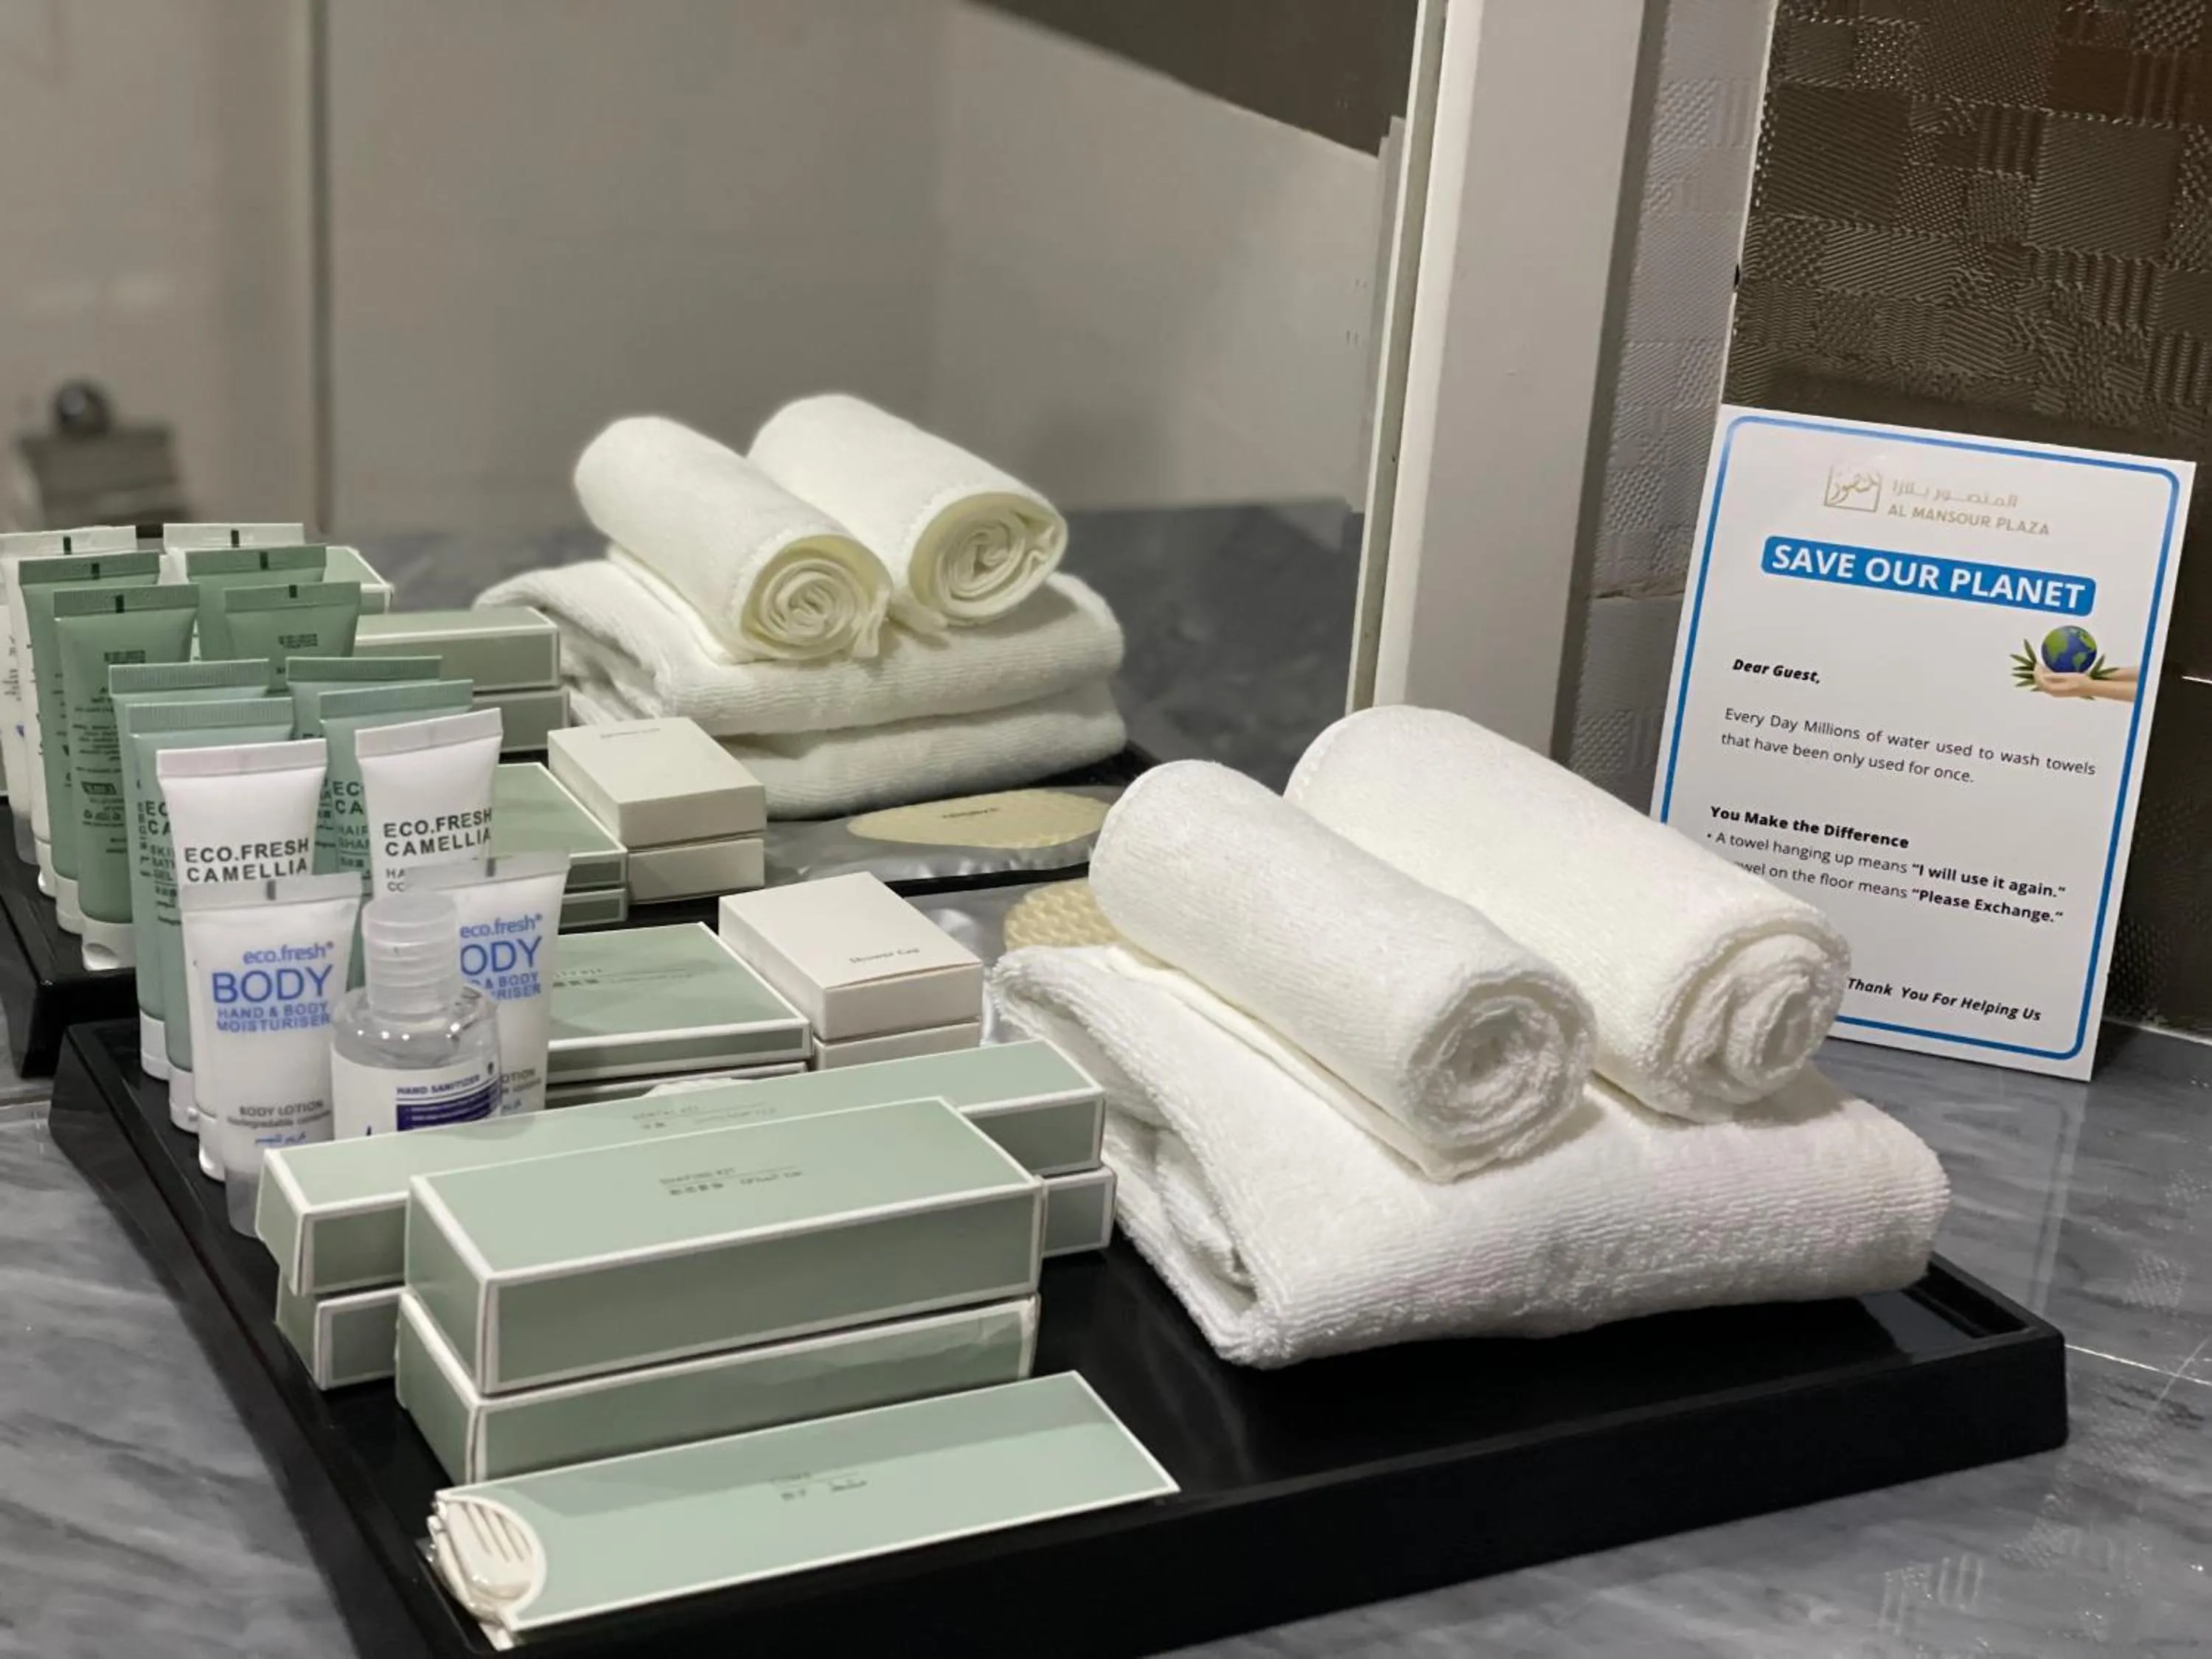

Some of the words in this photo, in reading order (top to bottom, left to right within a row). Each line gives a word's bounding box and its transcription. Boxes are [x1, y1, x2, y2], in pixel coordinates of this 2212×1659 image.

[1888, 504, 1907, 518] AL
[1911, 507, 1991, 528] MANSOUR
[1995, 518, 2051, 536] PLAZA
[1771, 544, 1856, 579] SAVE
[1864, 557, 1940, 591] OUR
[1949, 568, 2086, 610] PLANET
[1732, 658, 1770, 675] Dear
[1773, 665, 1820, 685] Guest,
[1725, 708, 1764, 728] Every
[1770, 714, 1798, 734] Day
[1804, 720, 1860, 740] Millions
[1866, 729, 1883, 743] of
[1887, 734, 1930, 751] water
[1935, 741, 1973, 757] used
[1978, 747, 1994, 760] to
[2000, 751, 2040, 767] wash
[2045, 757, 2097, 776] towels
[1721, 733, 1751, 749] that
[1754, 737, 1789, 754] have
[1792, 743, 1829, 761] been
[1833, 752, 1865, 770] only
[1868, 757, 1905, 773] used
[1908, 761, 1930, 776] for
[1933, 766, 1975, 784] once.
[383, 807, 493, 839] ECO.FRESH
[1710, 806, 1740, 821] You
[1744, 811, 1789, 830] Make
[1792, 818, 1820, 835] the
[1823, 824, 1910, 849] Difference
[184, 838, 310, 864] ECO.FRESH
[385, 827, 493, 858] CAMELLIA
[187, 858, 309, 883] CAMELLIA
[1715, 832, 1726, 844] A
[1730, 834, 1770, 851] towel
[1772, 840, 1832, 864] hanging
[1834, 853, 1854, 867] up
[1858, 858, 1908, 874] means
[1927, 866, 1956, 881] will
[1960, 872, 1989, 887] use
[1992, 875, 2005, 889] it
[1769, 868, 1788, 880] on
[1792, 869, 1816, 884] the
[1820, 873, 1854, 889] floor
[1857, 882, 1908, 899] means
[459, 935, 543, 977] ODY
[211, 964, 334, 1004] BODY
[498, 970, 540, 990] BODY
[217, 1006, 264, 1019] HAND
[268, 1005, 279, 1018] &
[283, 1001, 329, 1017] BODY
[1847, 978, 1893, 996] Thank
[1901, 987, 1929, 1002] You
[1932, 992, 1958, 1007] For
[1961, 996, 2020, 1020] Helping
[2023, 1007, 2042, 1022] Us
[216, 1013, 332, 1033] MOISTURISER
[397, 1085, 428, 1096] HAND
[240, 1105, 275, 1117] BODY
[278, 1099, 324, 1116] LOTION
